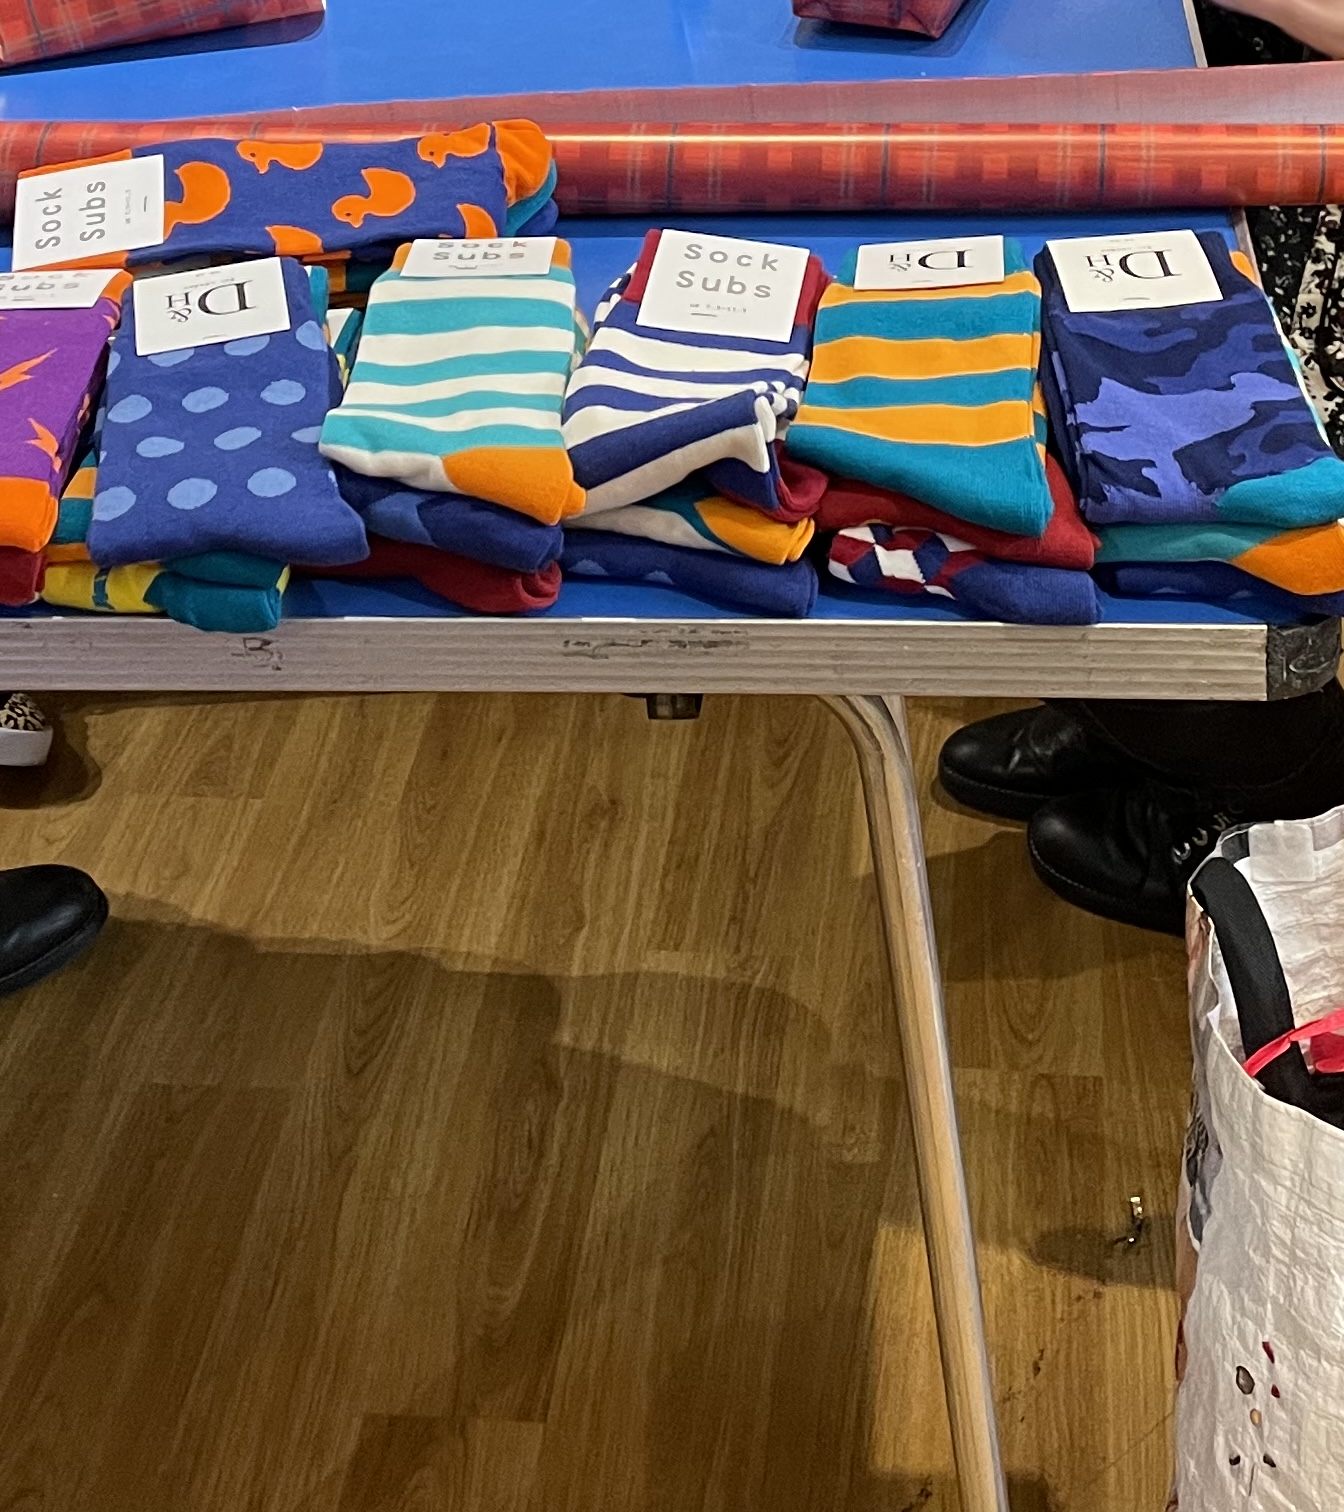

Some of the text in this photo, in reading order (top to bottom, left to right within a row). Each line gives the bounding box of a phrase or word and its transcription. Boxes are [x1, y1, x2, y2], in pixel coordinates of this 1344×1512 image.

[35, 187, 63, 250] Sock
[78, 181, 106, 242] Subs
[433, 251, 525, 261] Subs
[438, 240, 527, 249] Sock
[684, 243, 779, 272] Sock
[676, 270, 771, 298] Subs
